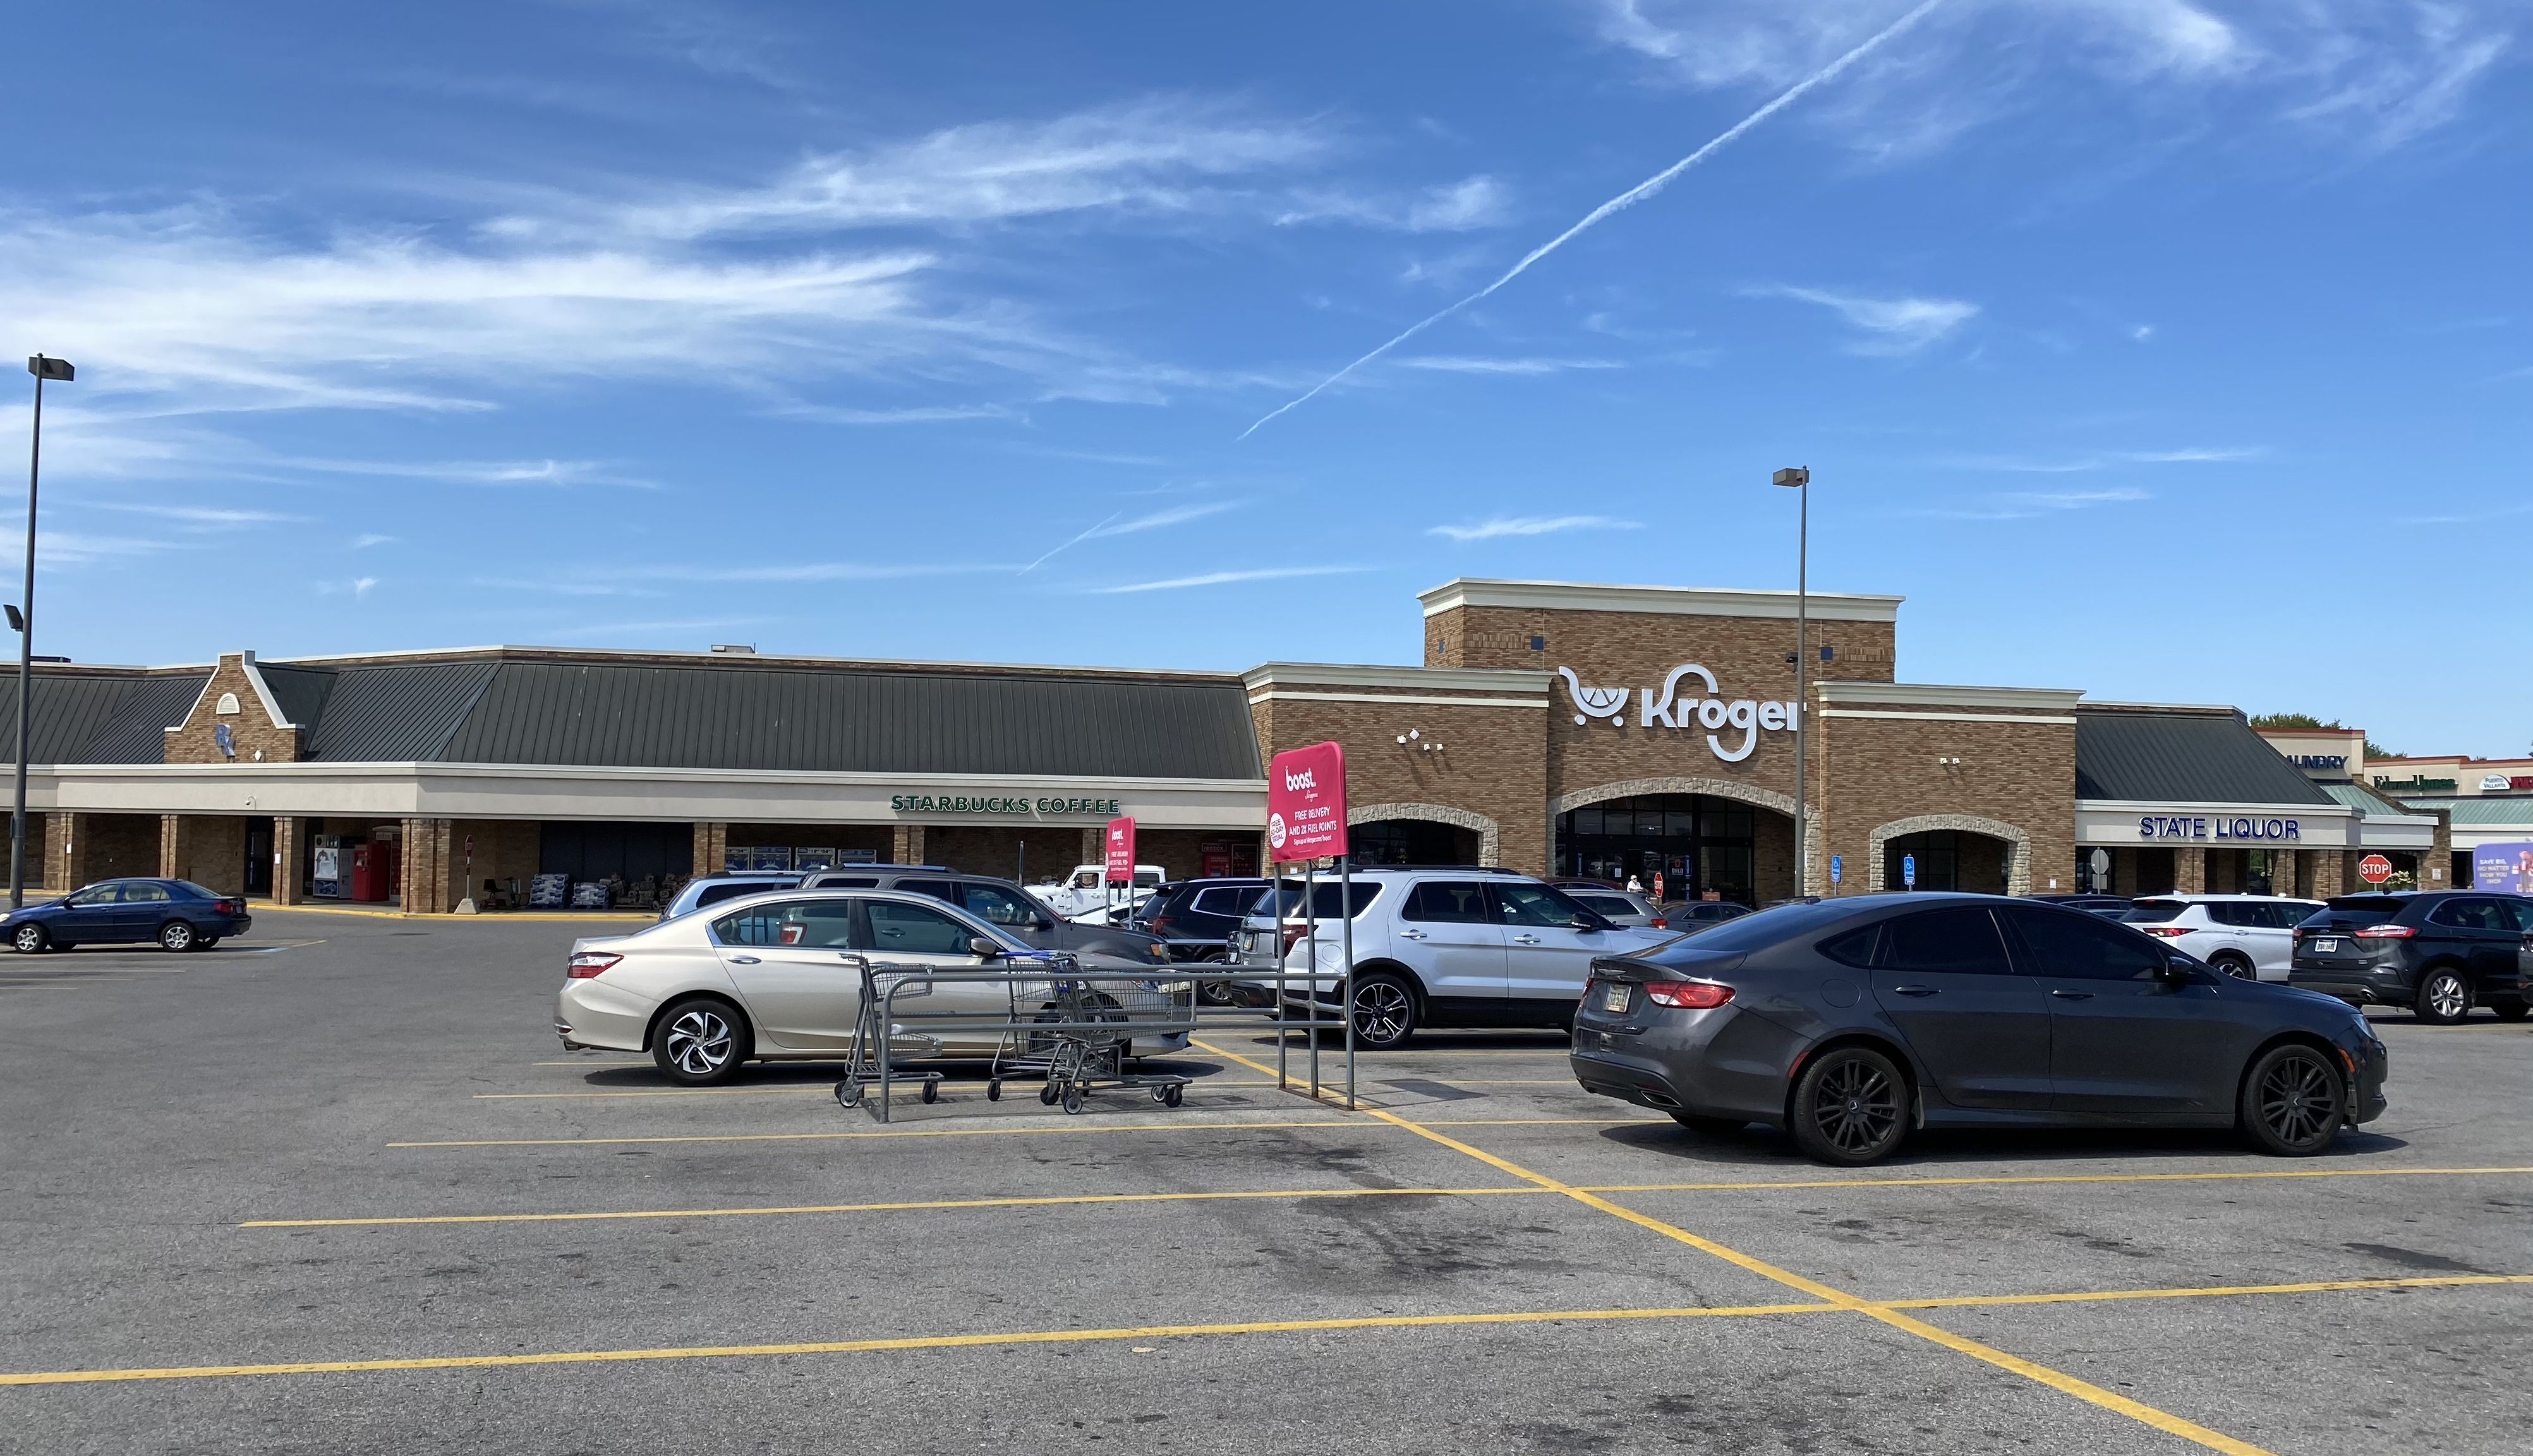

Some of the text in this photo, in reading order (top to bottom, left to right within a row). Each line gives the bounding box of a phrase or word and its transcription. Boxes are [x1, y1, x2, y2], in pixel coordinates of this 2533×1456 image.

[1641, 663, 1807, 762] Kroger
[891, 795, 1121, 814] STARBUCKS COFFEE
[1295, 806, 1331, 821] FREE DELIVERY
[1289, 825, 1300, 836] AND
[1307, 823, 1319, 834] FUEL
[1319, 821, 1337, 832] POINTS
[2139, 817, 2299, 839] STATE LIQUOR
[2362, 863, 2389, 875] STOP
